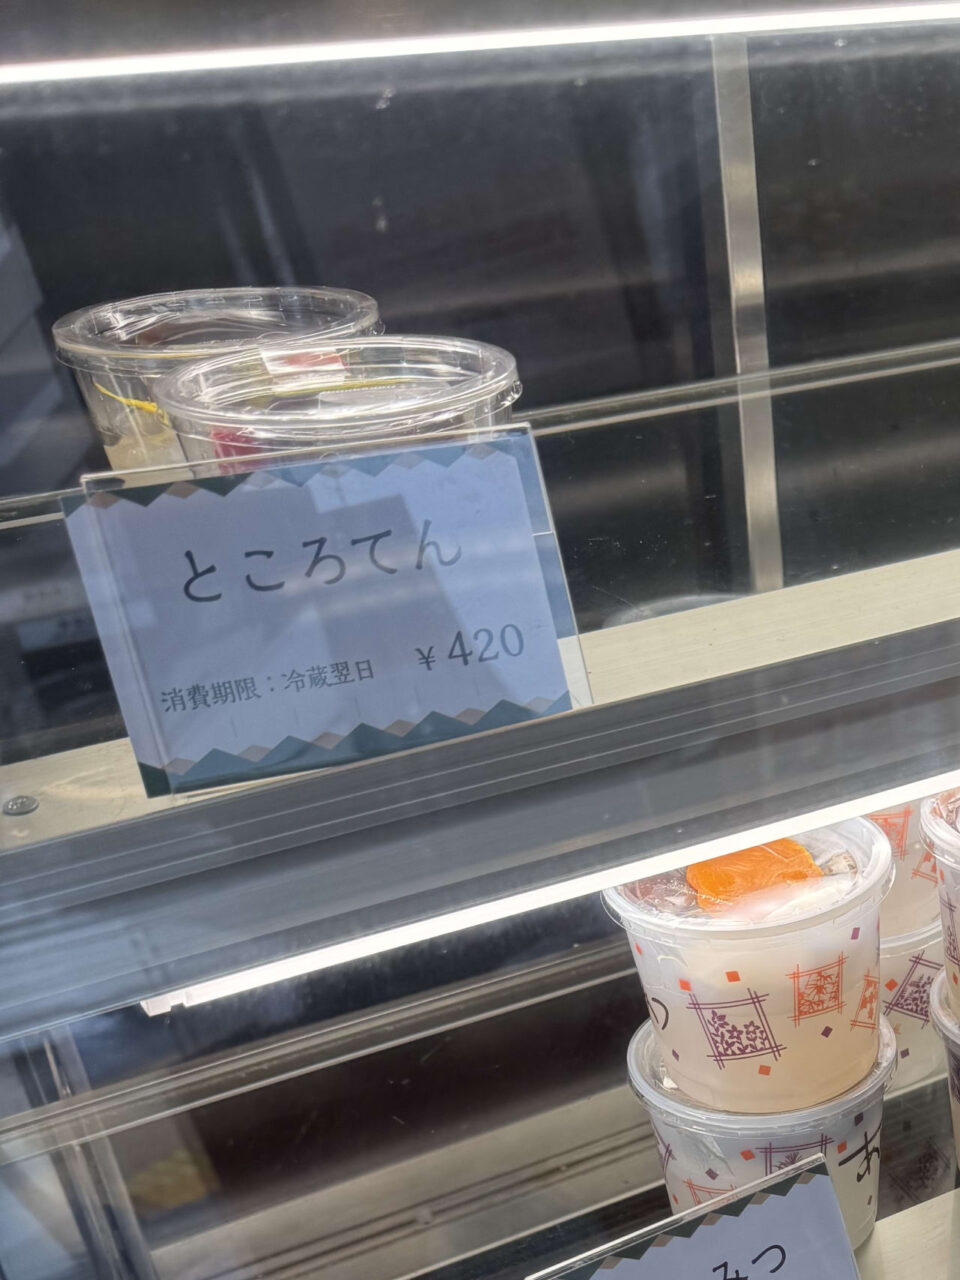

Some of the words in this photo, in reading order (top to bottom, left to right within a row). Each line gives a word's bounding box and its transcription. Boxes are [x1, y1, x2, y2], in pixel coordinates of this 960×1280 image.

[181, 520, 462, 604] ところてん
[415, 622, 525, 672] ¥420
[160, 659, 375, 714] 消費期限：冷蔵翌日
